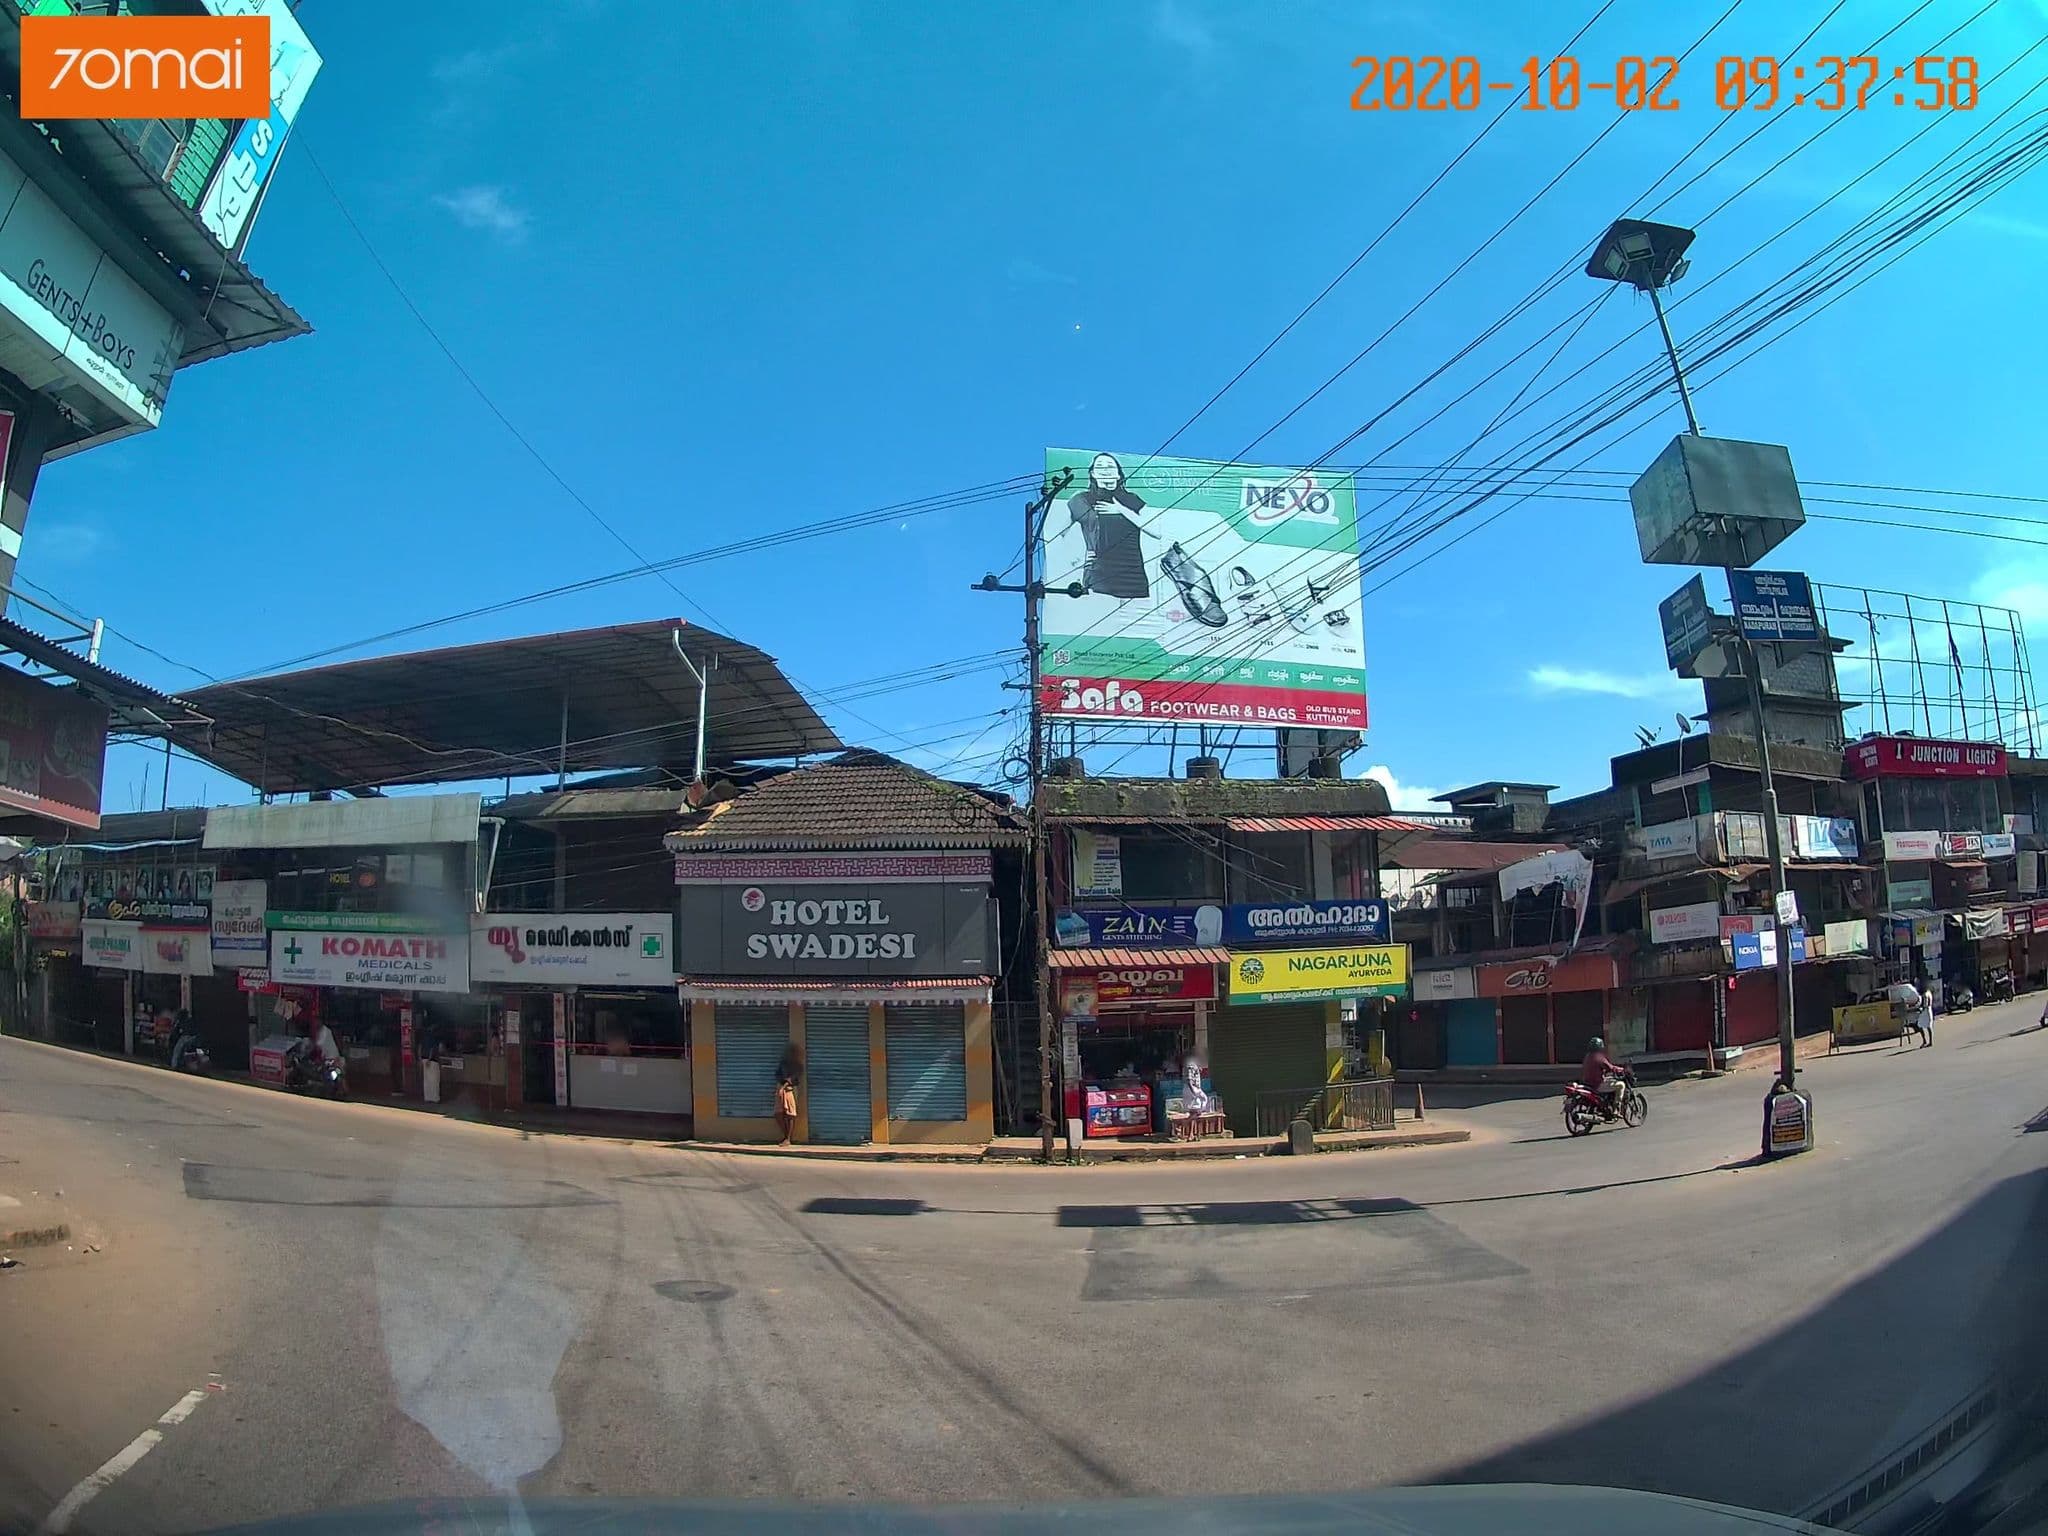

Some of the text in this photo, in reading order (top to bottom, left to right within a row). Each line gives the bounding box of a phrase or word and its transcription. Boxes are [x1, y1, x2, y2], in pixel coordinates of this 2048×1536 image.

[1246, 477, 1330, 520] NEXO
[1061, 679, 1297, 721] Safa FOOTWEAR & BAGS
[1305, 704, 1321, 713] OLD
[1338, 707, 1361, 716] STAND
[1305, 713, 1349, 724] KUTTIADY
[1910, 745, 1960, 764] JUNCTION
[1966, 748, 1996, 766] LIGHTS
[770, 900, 890, 926] HOTEL
[322, 936, 447, 959] KOMATH
[746, 932, 916, 960] SWADESI
[358, 959, 433, 971] MEDICALS
[1288, 952, 1392, 972] NAGARJUNA
[1348, 968, 1392, 979] AYURVEDA
